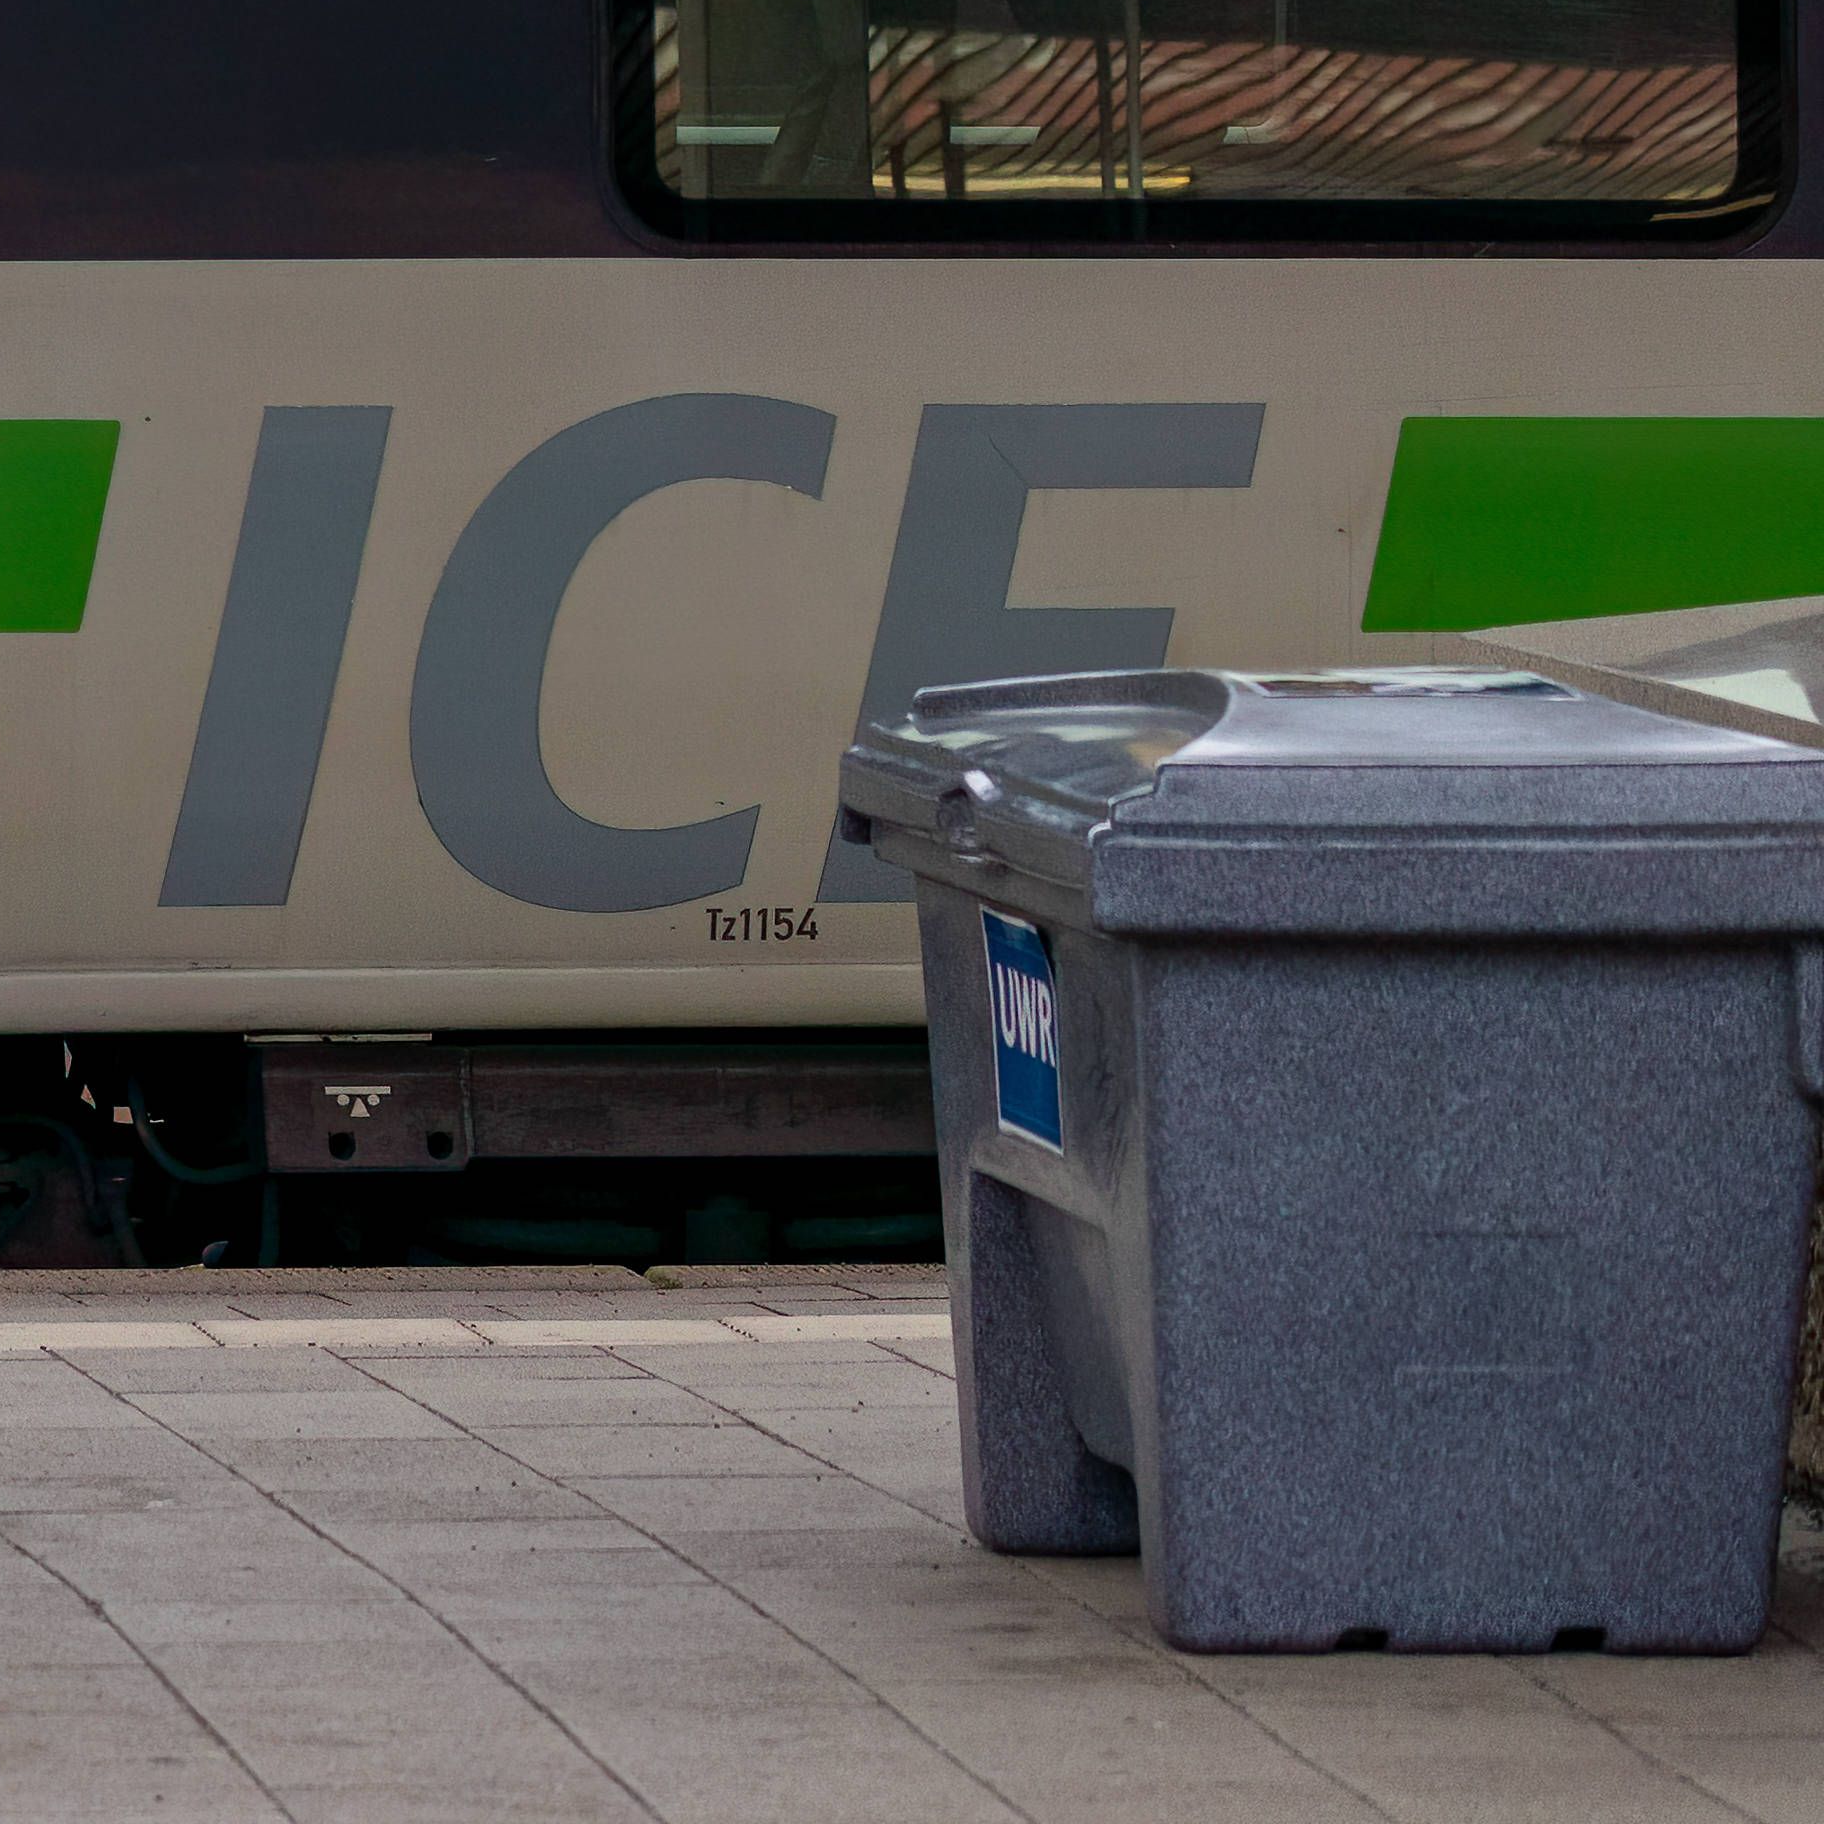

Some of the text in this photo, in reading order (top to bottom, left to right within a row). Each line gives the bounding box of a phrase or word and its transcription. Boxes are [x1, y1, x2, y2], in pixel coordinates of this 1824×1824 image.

[156, 392, 1264, 914] ICE
[706, 907, 819, 941] Tz1154
[995, 961, 1057, 1068] UWR
